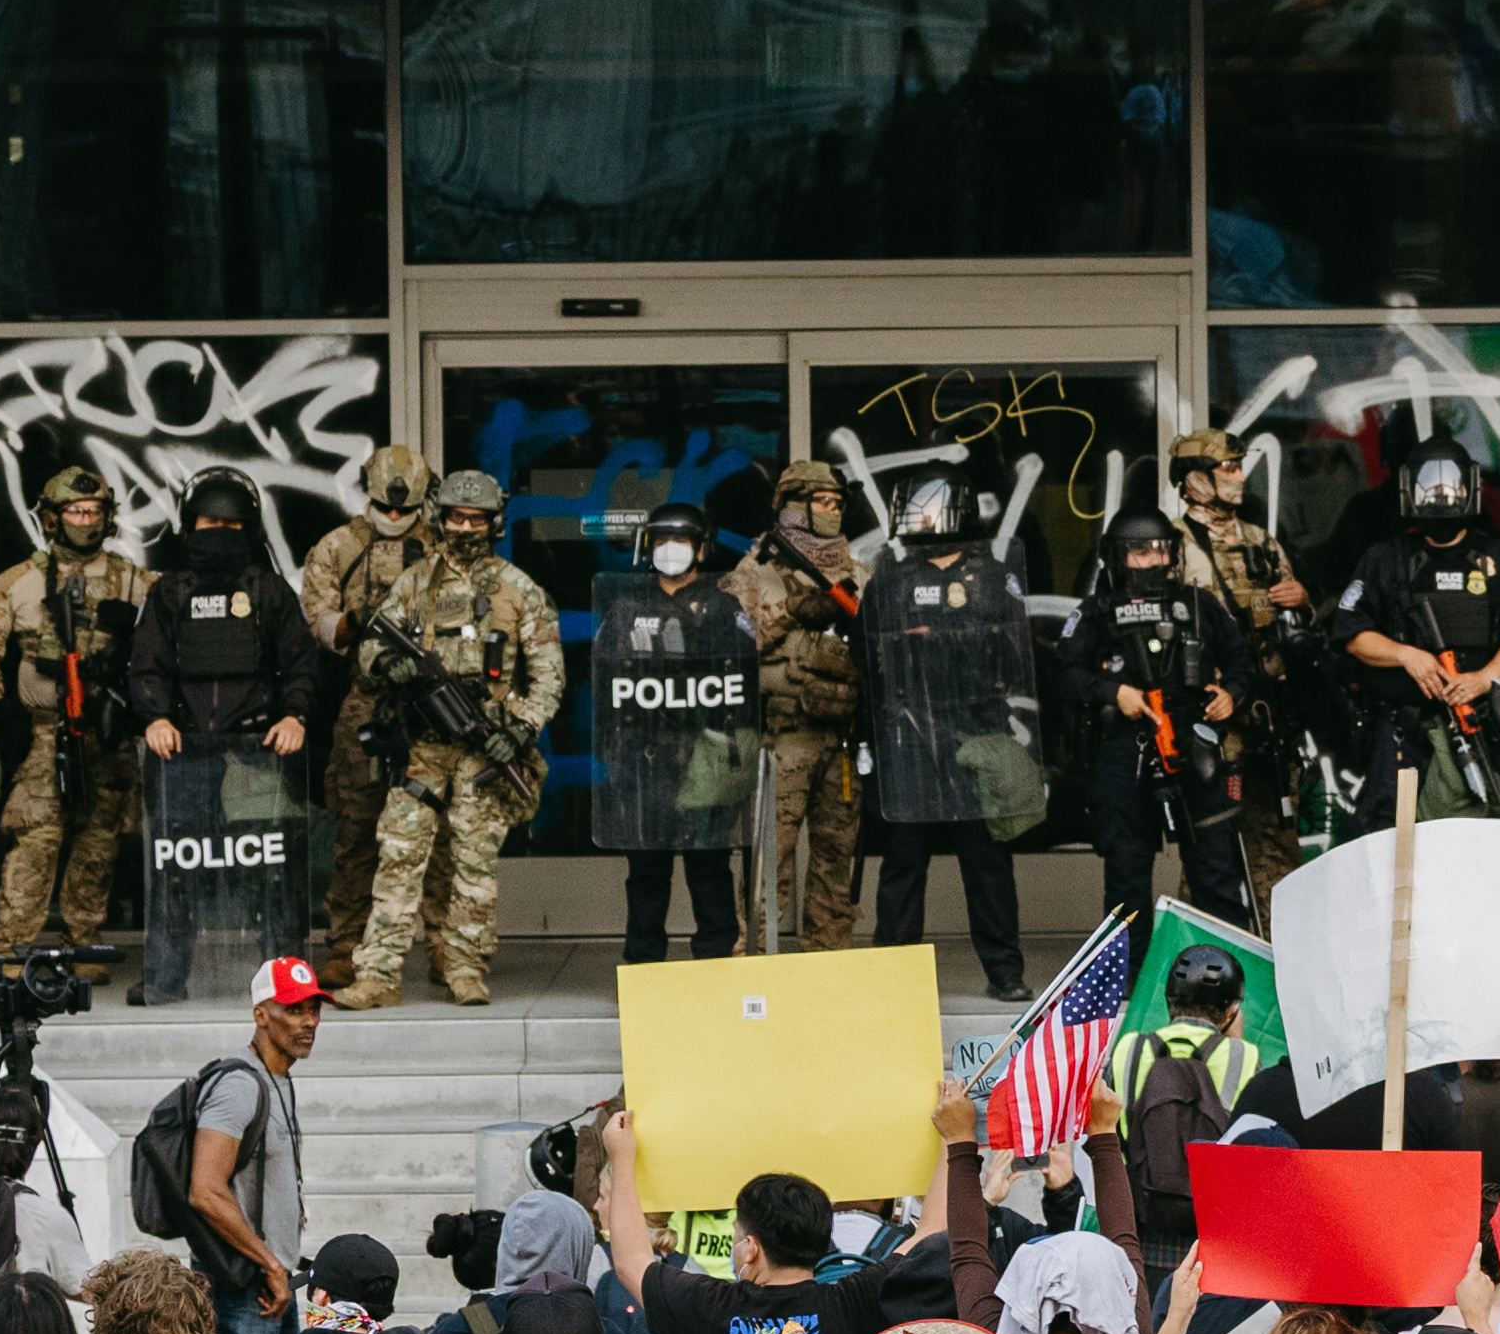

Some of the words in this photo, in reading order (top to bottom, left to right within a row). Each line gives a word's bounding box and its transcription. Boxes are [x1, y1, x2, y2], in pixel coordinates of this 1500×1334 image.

[625, 513, 645, 524] ONLY
[914, 586, 941, 597] POLICE
[191, 595, 227, 609] POLICE
[1115, 603, 1161, 616] POLICE
[612, 674, 744, 709] POLICE
[154, 832, 286, 870] POLICE
[960, 1041, 995, 1069] NO
[699, 1231, 736, 1258] PRES
